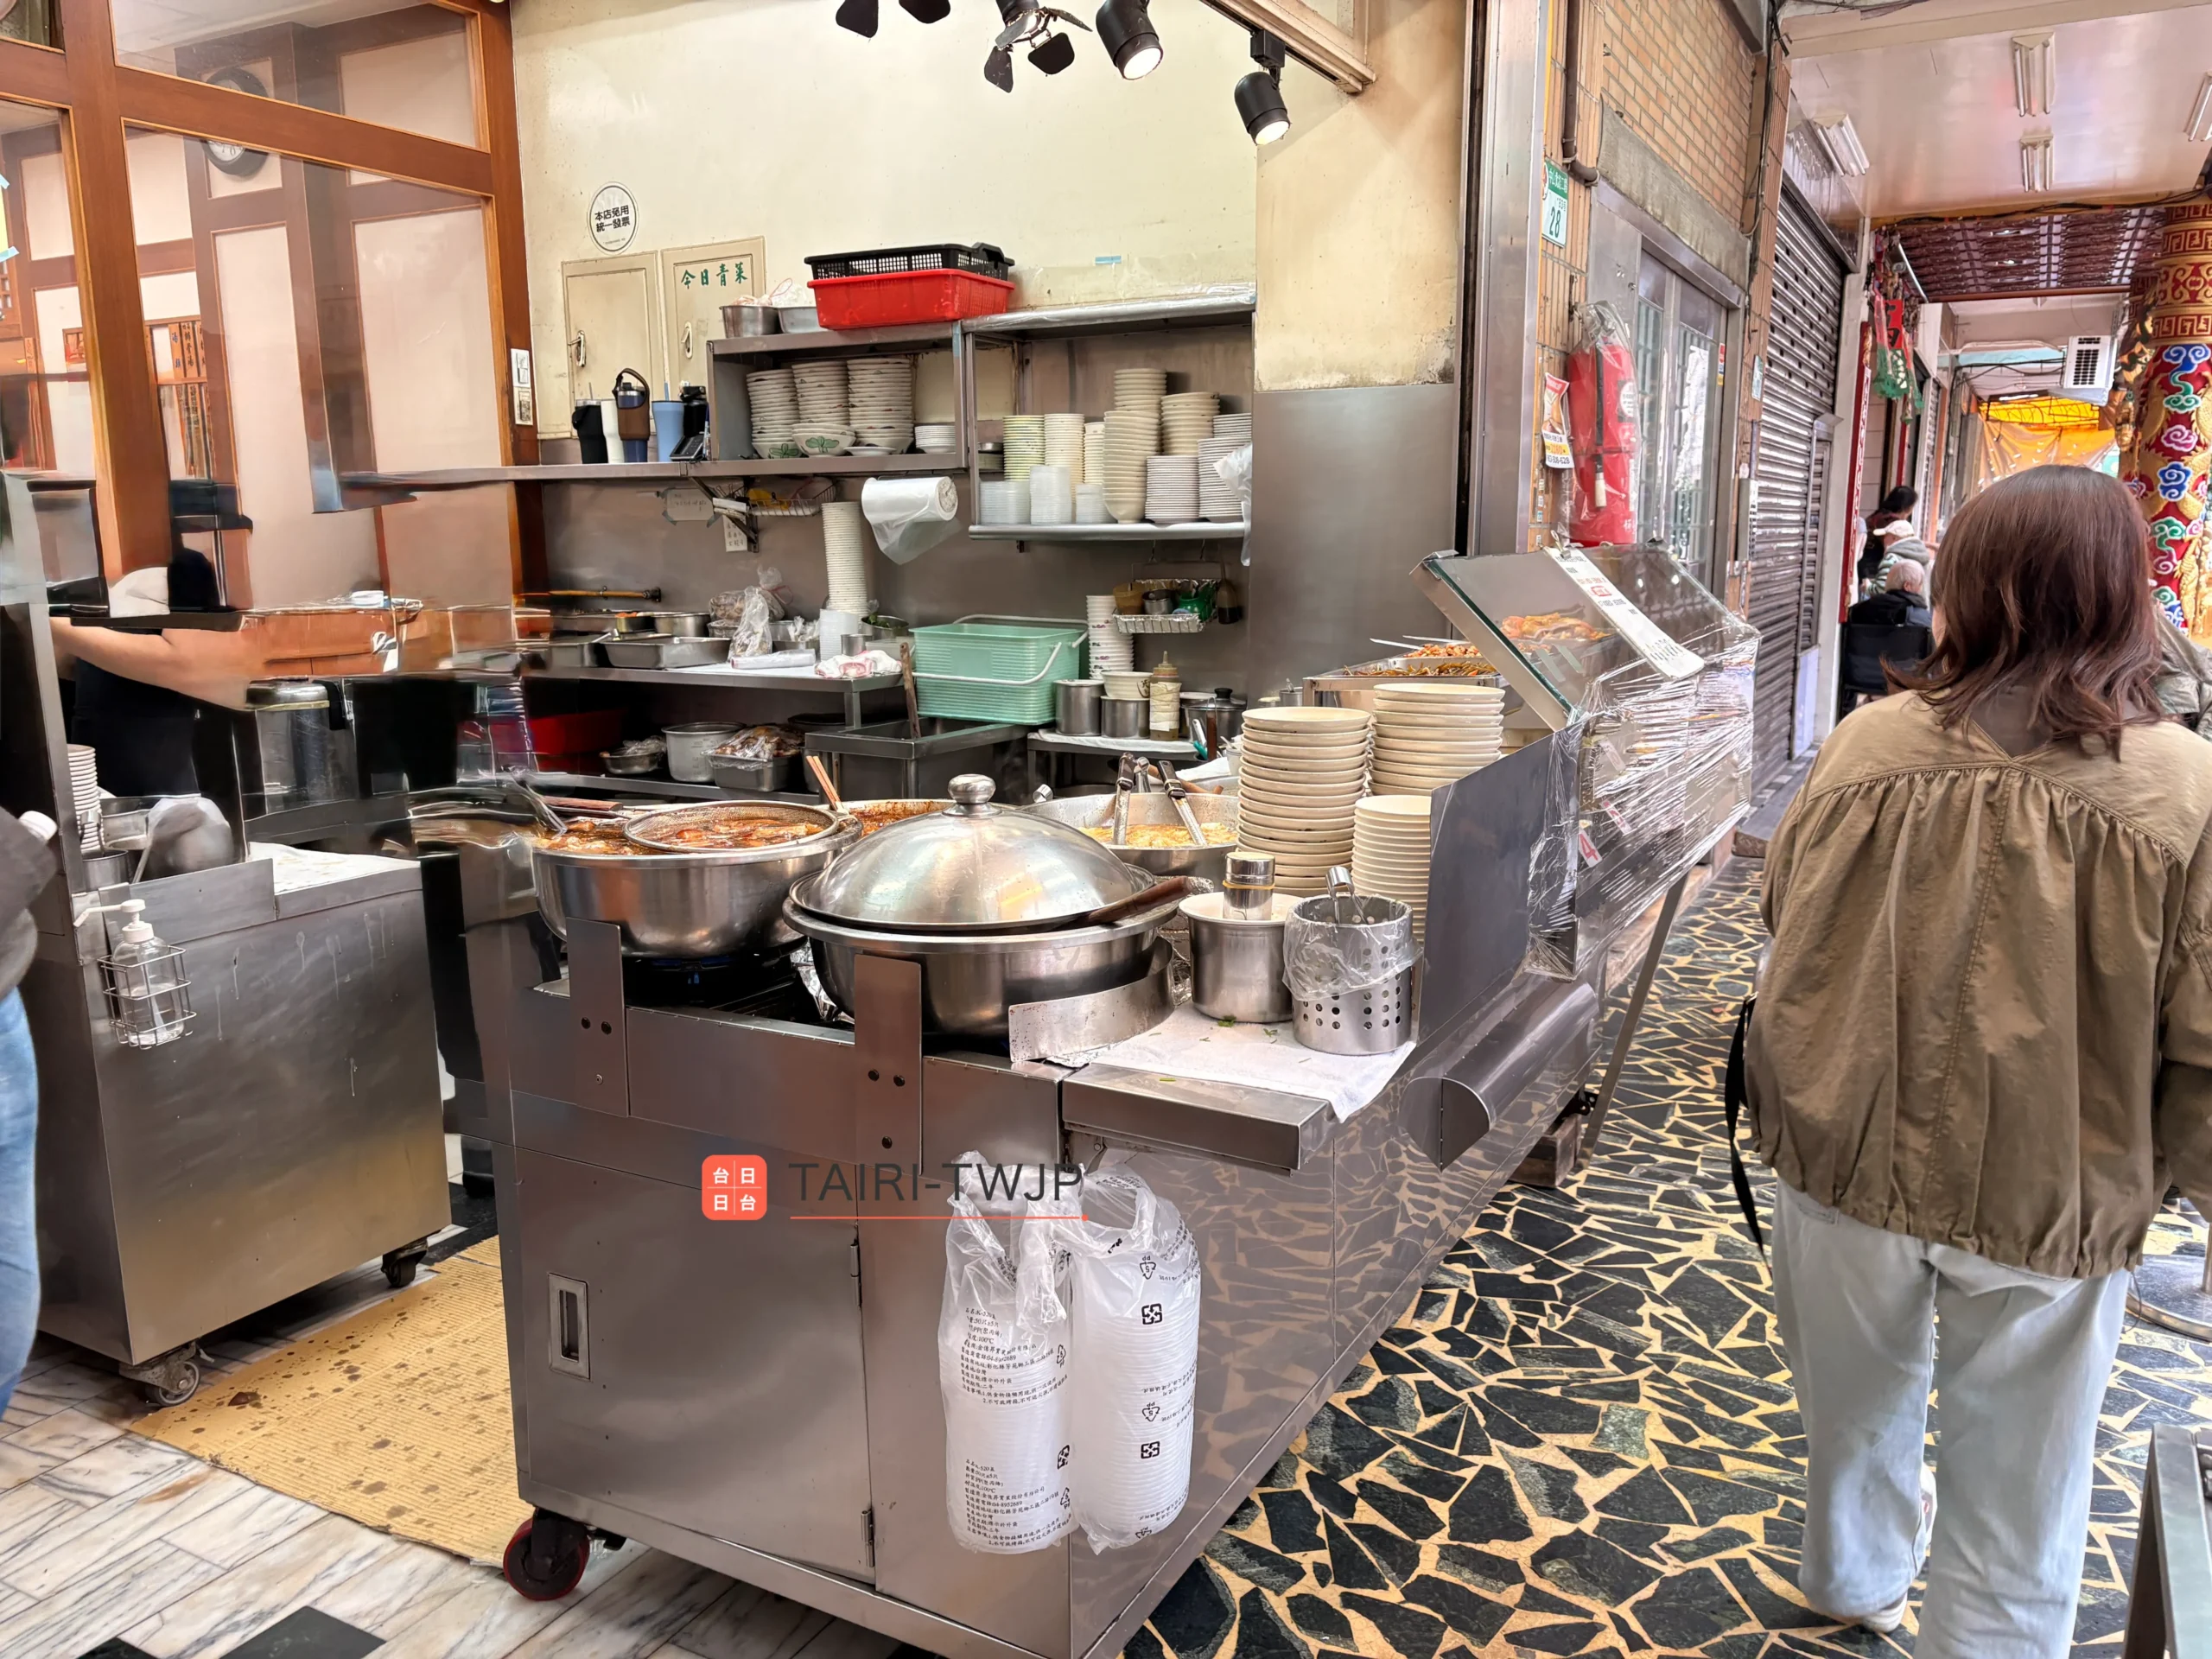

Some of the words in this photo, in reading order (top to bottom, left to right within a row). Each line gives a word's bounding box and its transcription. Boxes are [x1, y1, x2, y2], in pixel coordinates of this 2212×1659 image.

[594, 204, 629, 221] 本店免用
[595, 215, 631, 233] 統一發票
[1548, 206, 1561, 238] 28
[681, 261, 748, 289] 今日青菜
